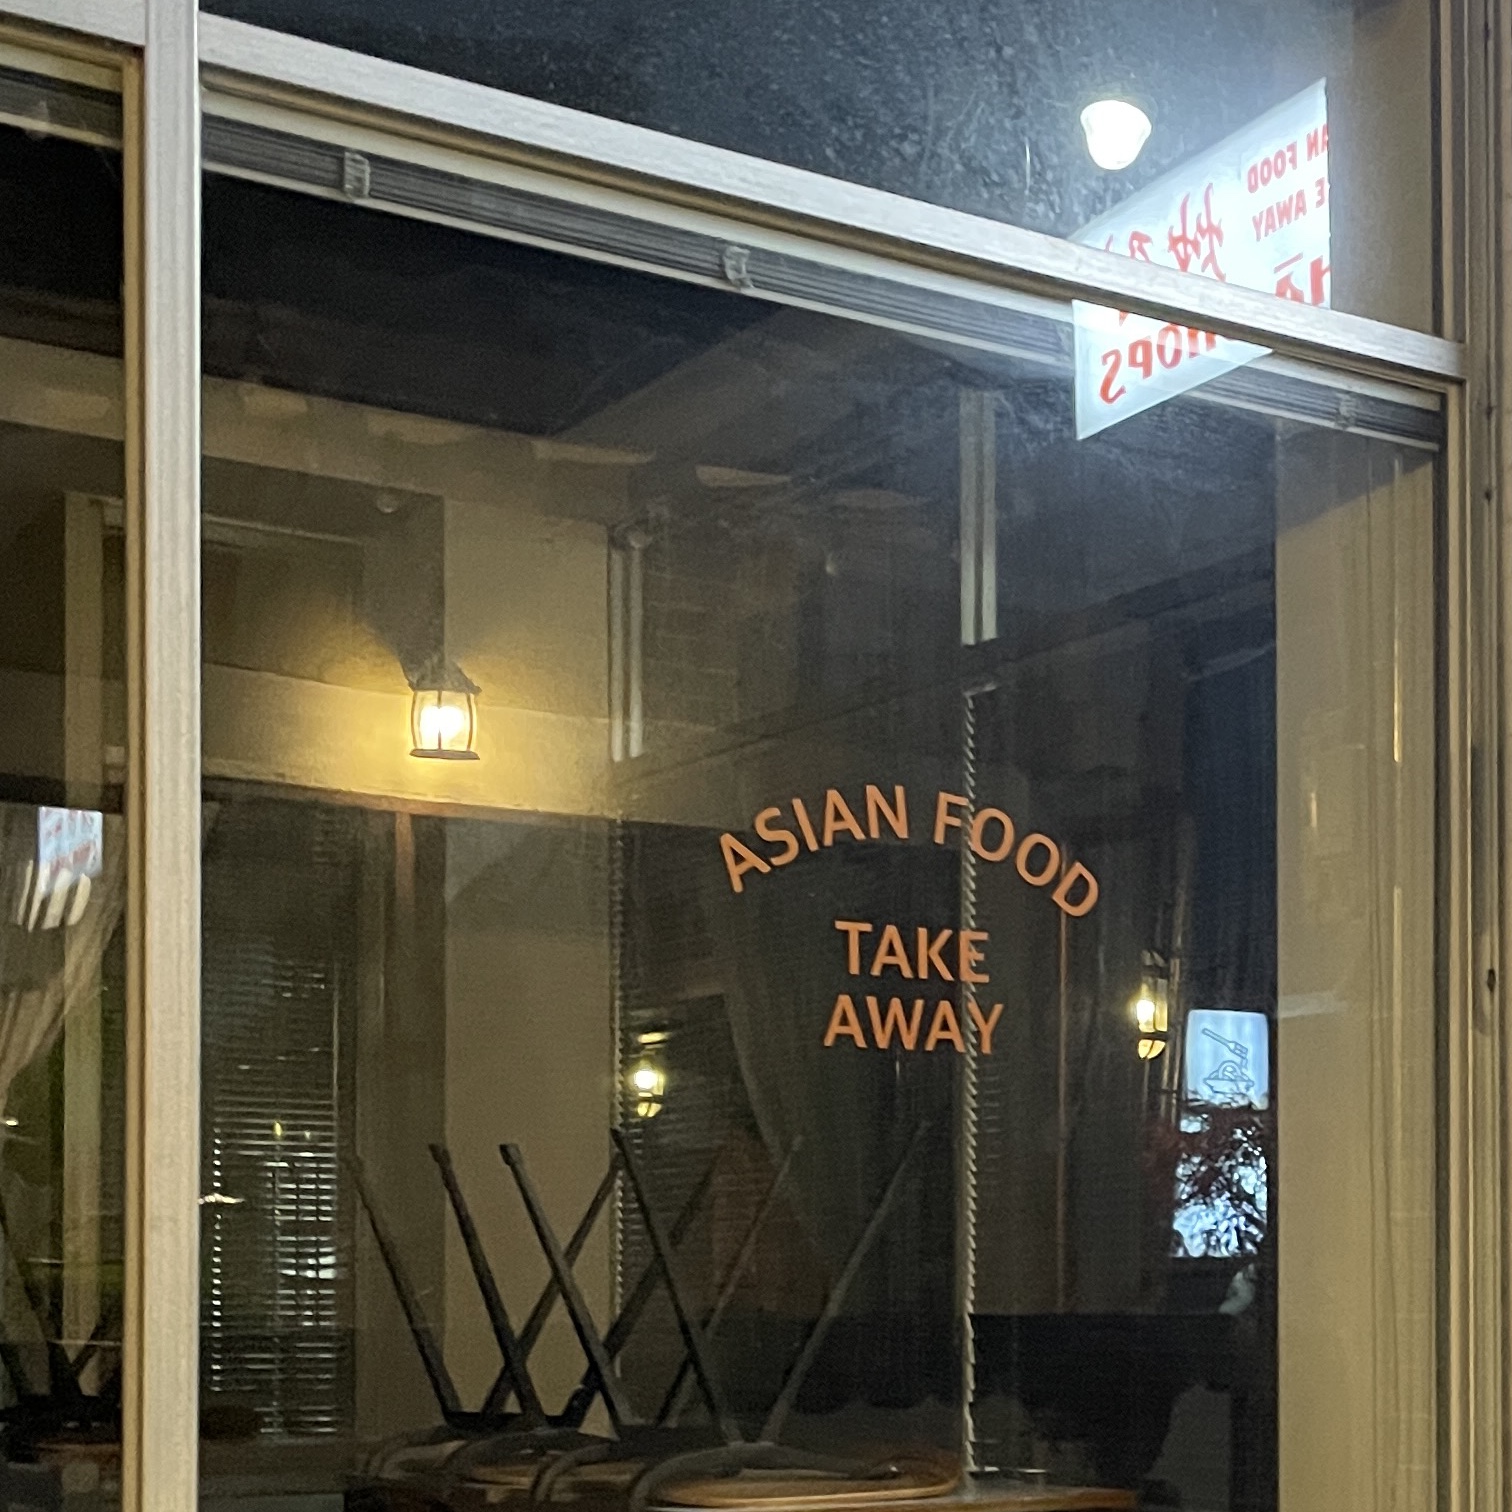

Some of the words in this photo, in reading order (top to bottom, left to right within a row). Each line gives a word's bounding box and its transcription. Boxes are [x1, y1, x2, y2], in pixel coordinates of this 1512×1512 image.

[719, 784, 909, 893] ASIAN
[933, 790, 1099, 918] FOOD
[834, 919, 990, 984] TAKE
[823, 994, 1005, 1055] AWAY
